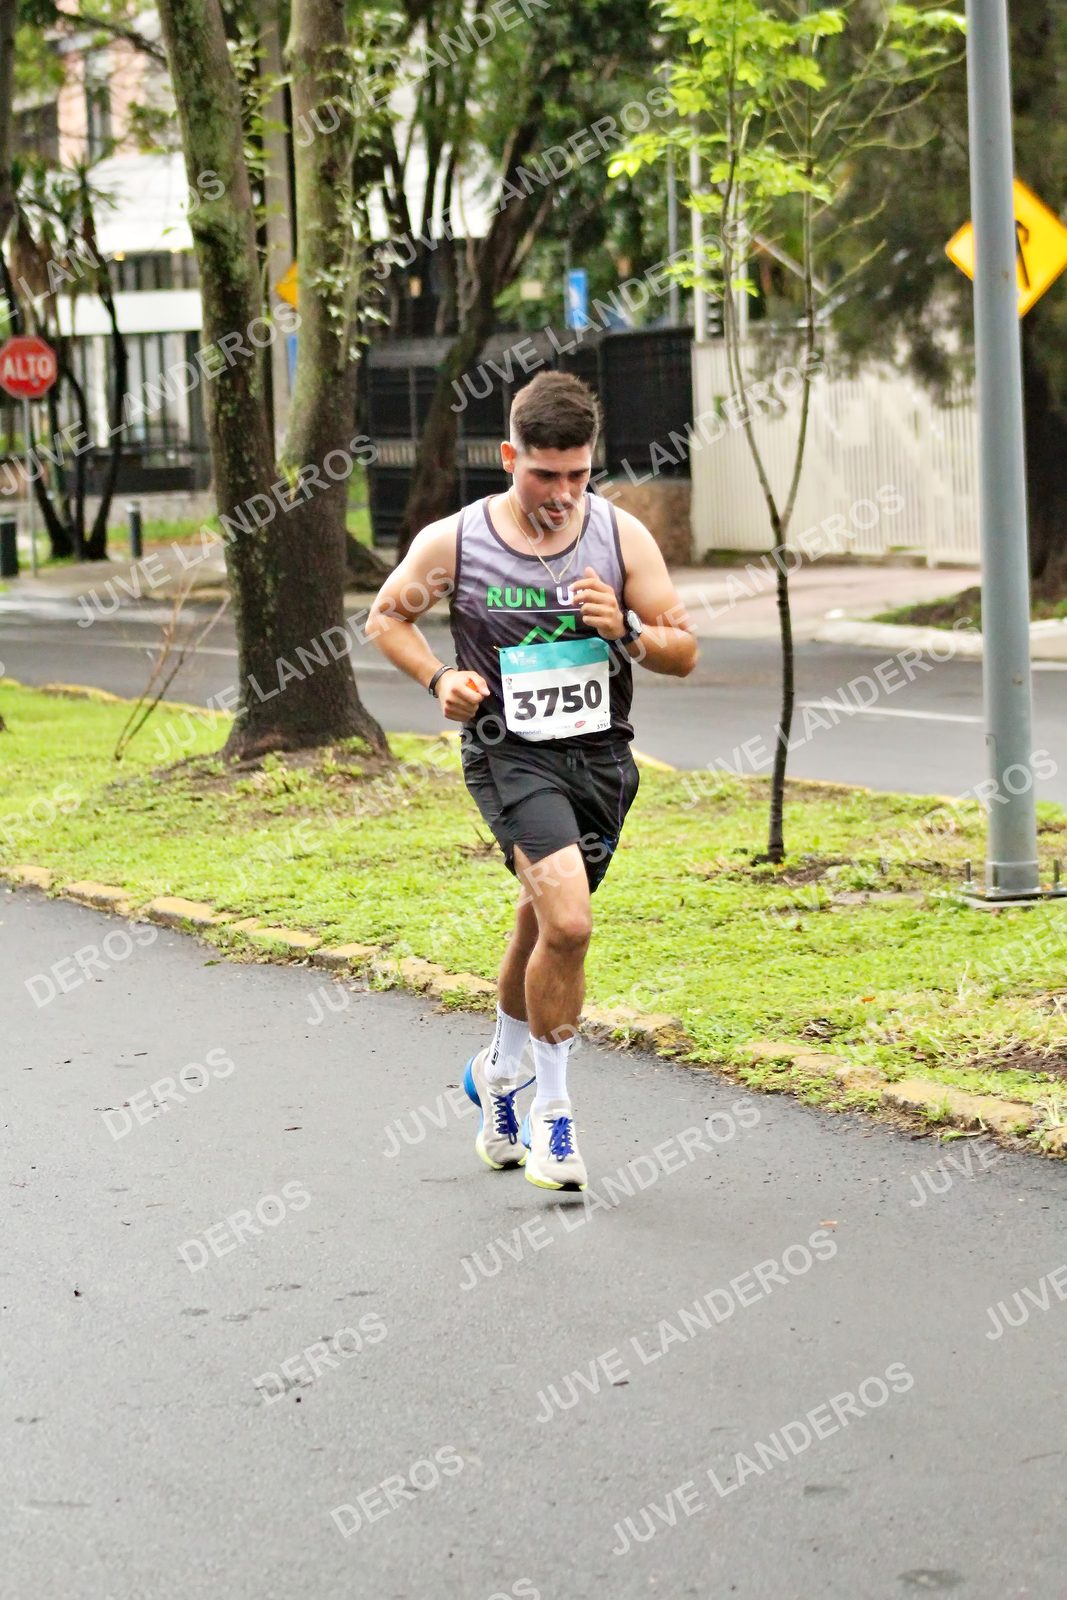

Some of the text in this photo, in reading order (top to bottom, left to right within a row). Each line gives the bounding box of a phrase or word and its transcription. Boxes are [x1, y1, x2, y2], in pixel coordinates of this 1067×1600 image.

[4, 353, 52, 380] ALTO
[487, 585, 592, 608] RUN U
[512, 680, 602, 721] 3750
